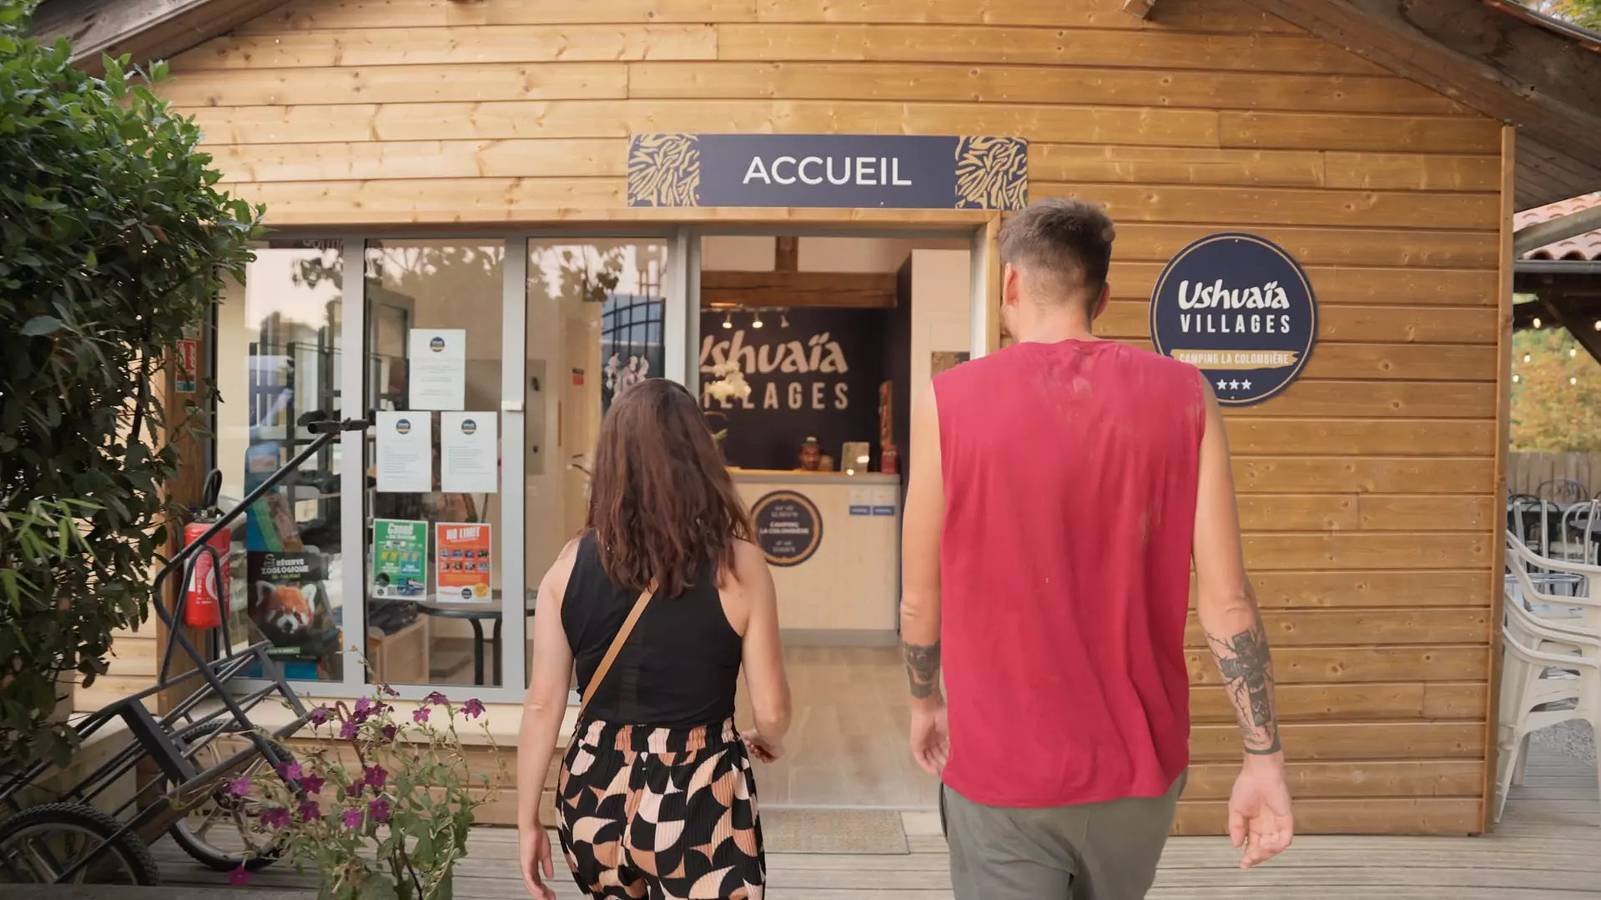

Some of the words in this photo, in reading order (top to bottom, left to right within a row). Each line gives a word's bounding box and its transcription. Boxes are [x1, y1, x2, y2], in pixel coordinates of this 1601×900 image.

[742, 155, 912, 187] ACCUEIL
[1178, 278, 1290, 310] Ushuaïa
[1180, 313, 1290, 333] VILLAGES
[1179, 352, 1218, 364] CAMPING
[1221, 353, 1232, 364] LA
[1235, 352, 1290, 365] COLOMBIÈRE
[703, 381, 849, 410] ILLAGES
